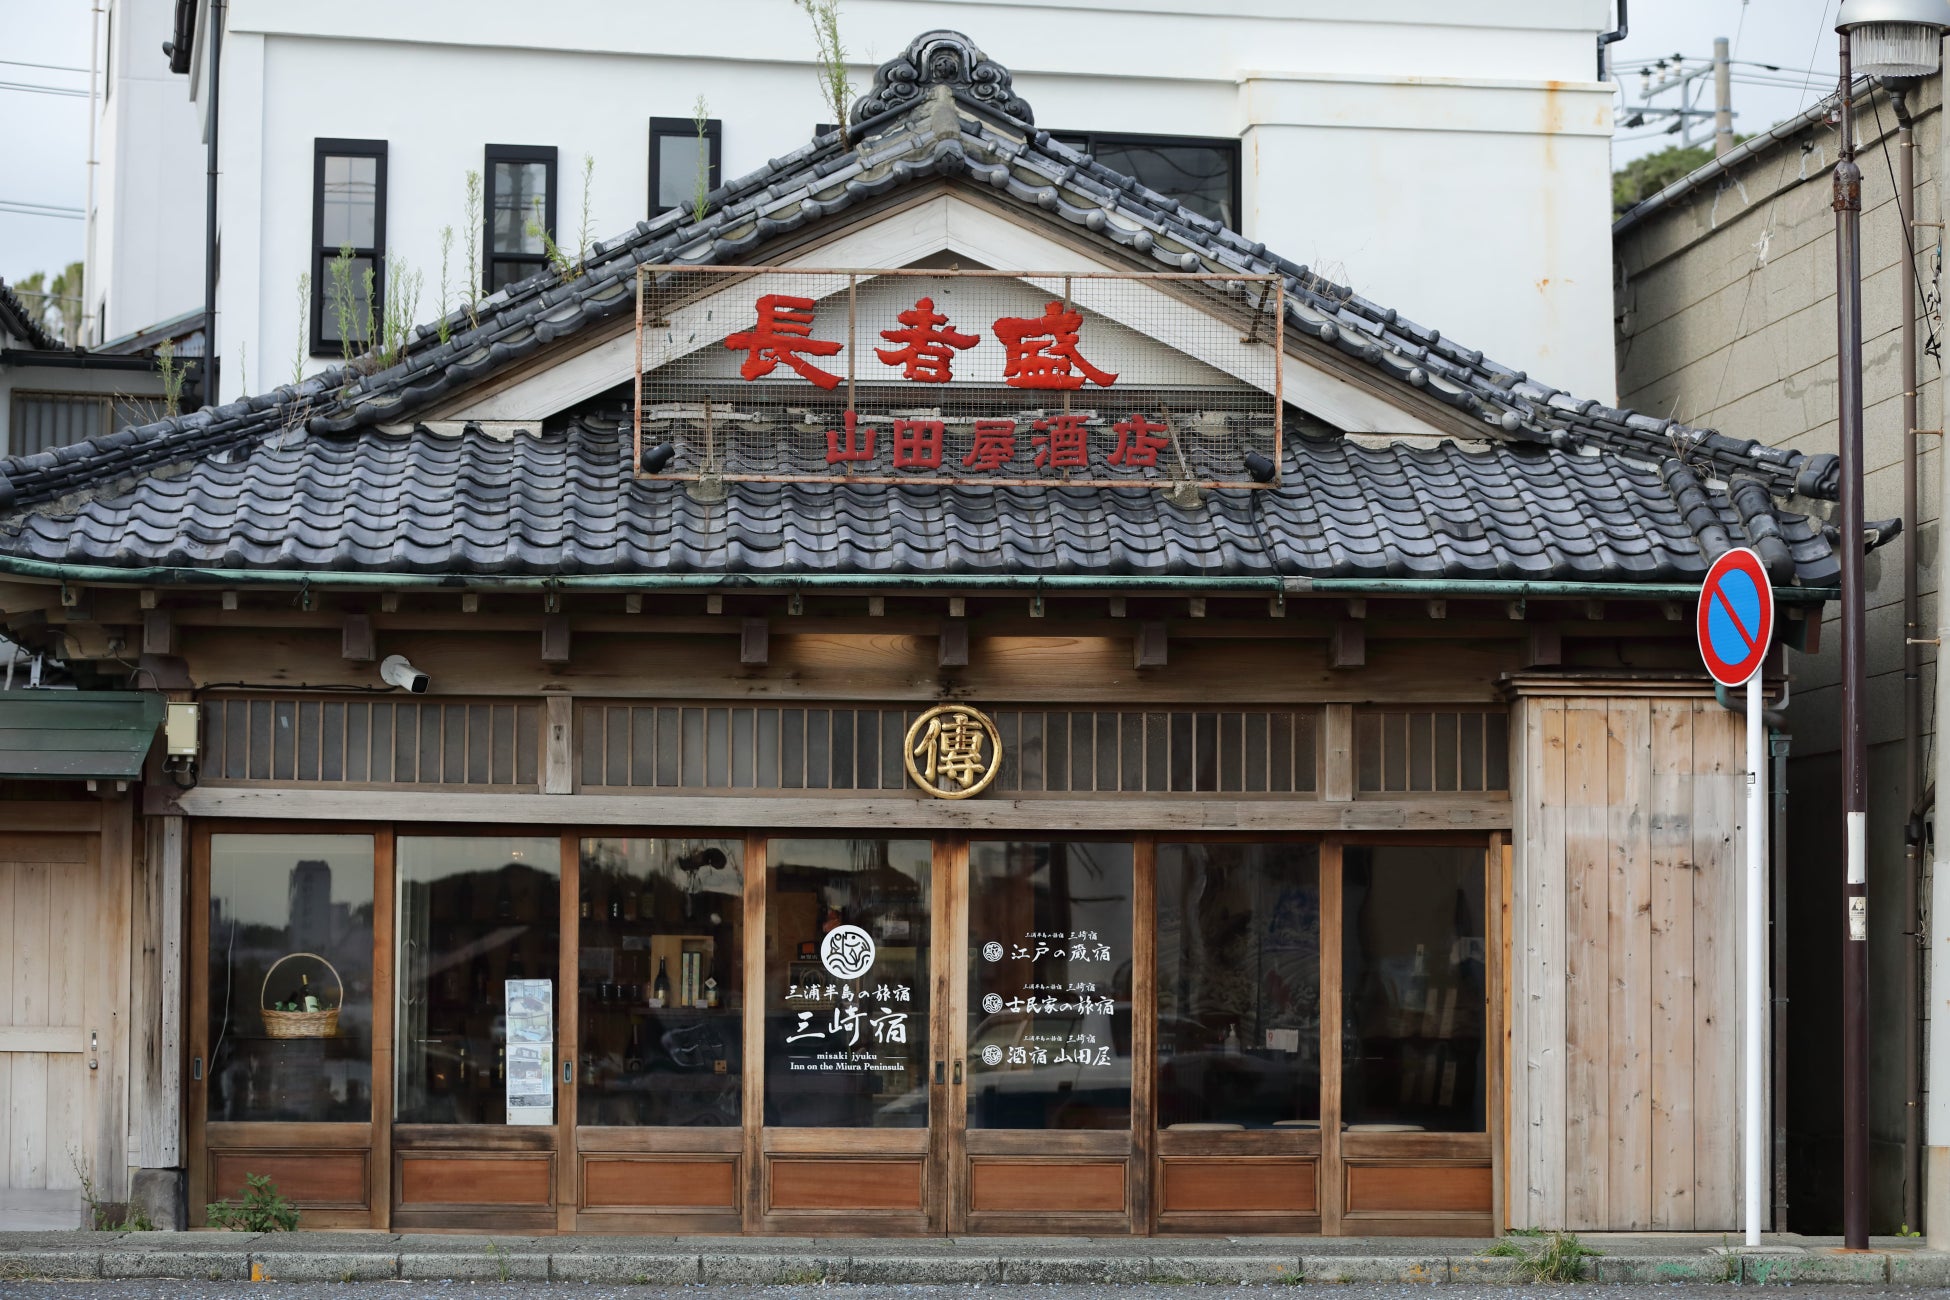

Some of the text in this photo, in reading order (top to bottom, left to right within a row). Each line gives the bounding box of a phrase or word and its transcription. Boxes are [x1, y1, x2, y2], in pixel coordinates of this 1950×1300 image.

[723, 293, 1120, 391] 長者盛
[825, 409, 1170, 470] 山田屋酒店
[1011, 942, 1111, 963] 江戸の蔵宿
[785, 984, 911, 1002] 三浦半島の旅宿
[1005, 995, 1115, 1016] 古民家の旅宿
[786, 1005, 908, 1047] 三崎宿
[817, 1052, 878, 1062] misaki jyuku
[1006, 1046, 1112, 1066] 酒宿 山田屋
[790, 1062, 805, 1071] Inn
[819, 1062, 834, 1071] the
[836, 1062, 862, 1071] Miura
[864, 1062, 905, 1072] Peninsula
